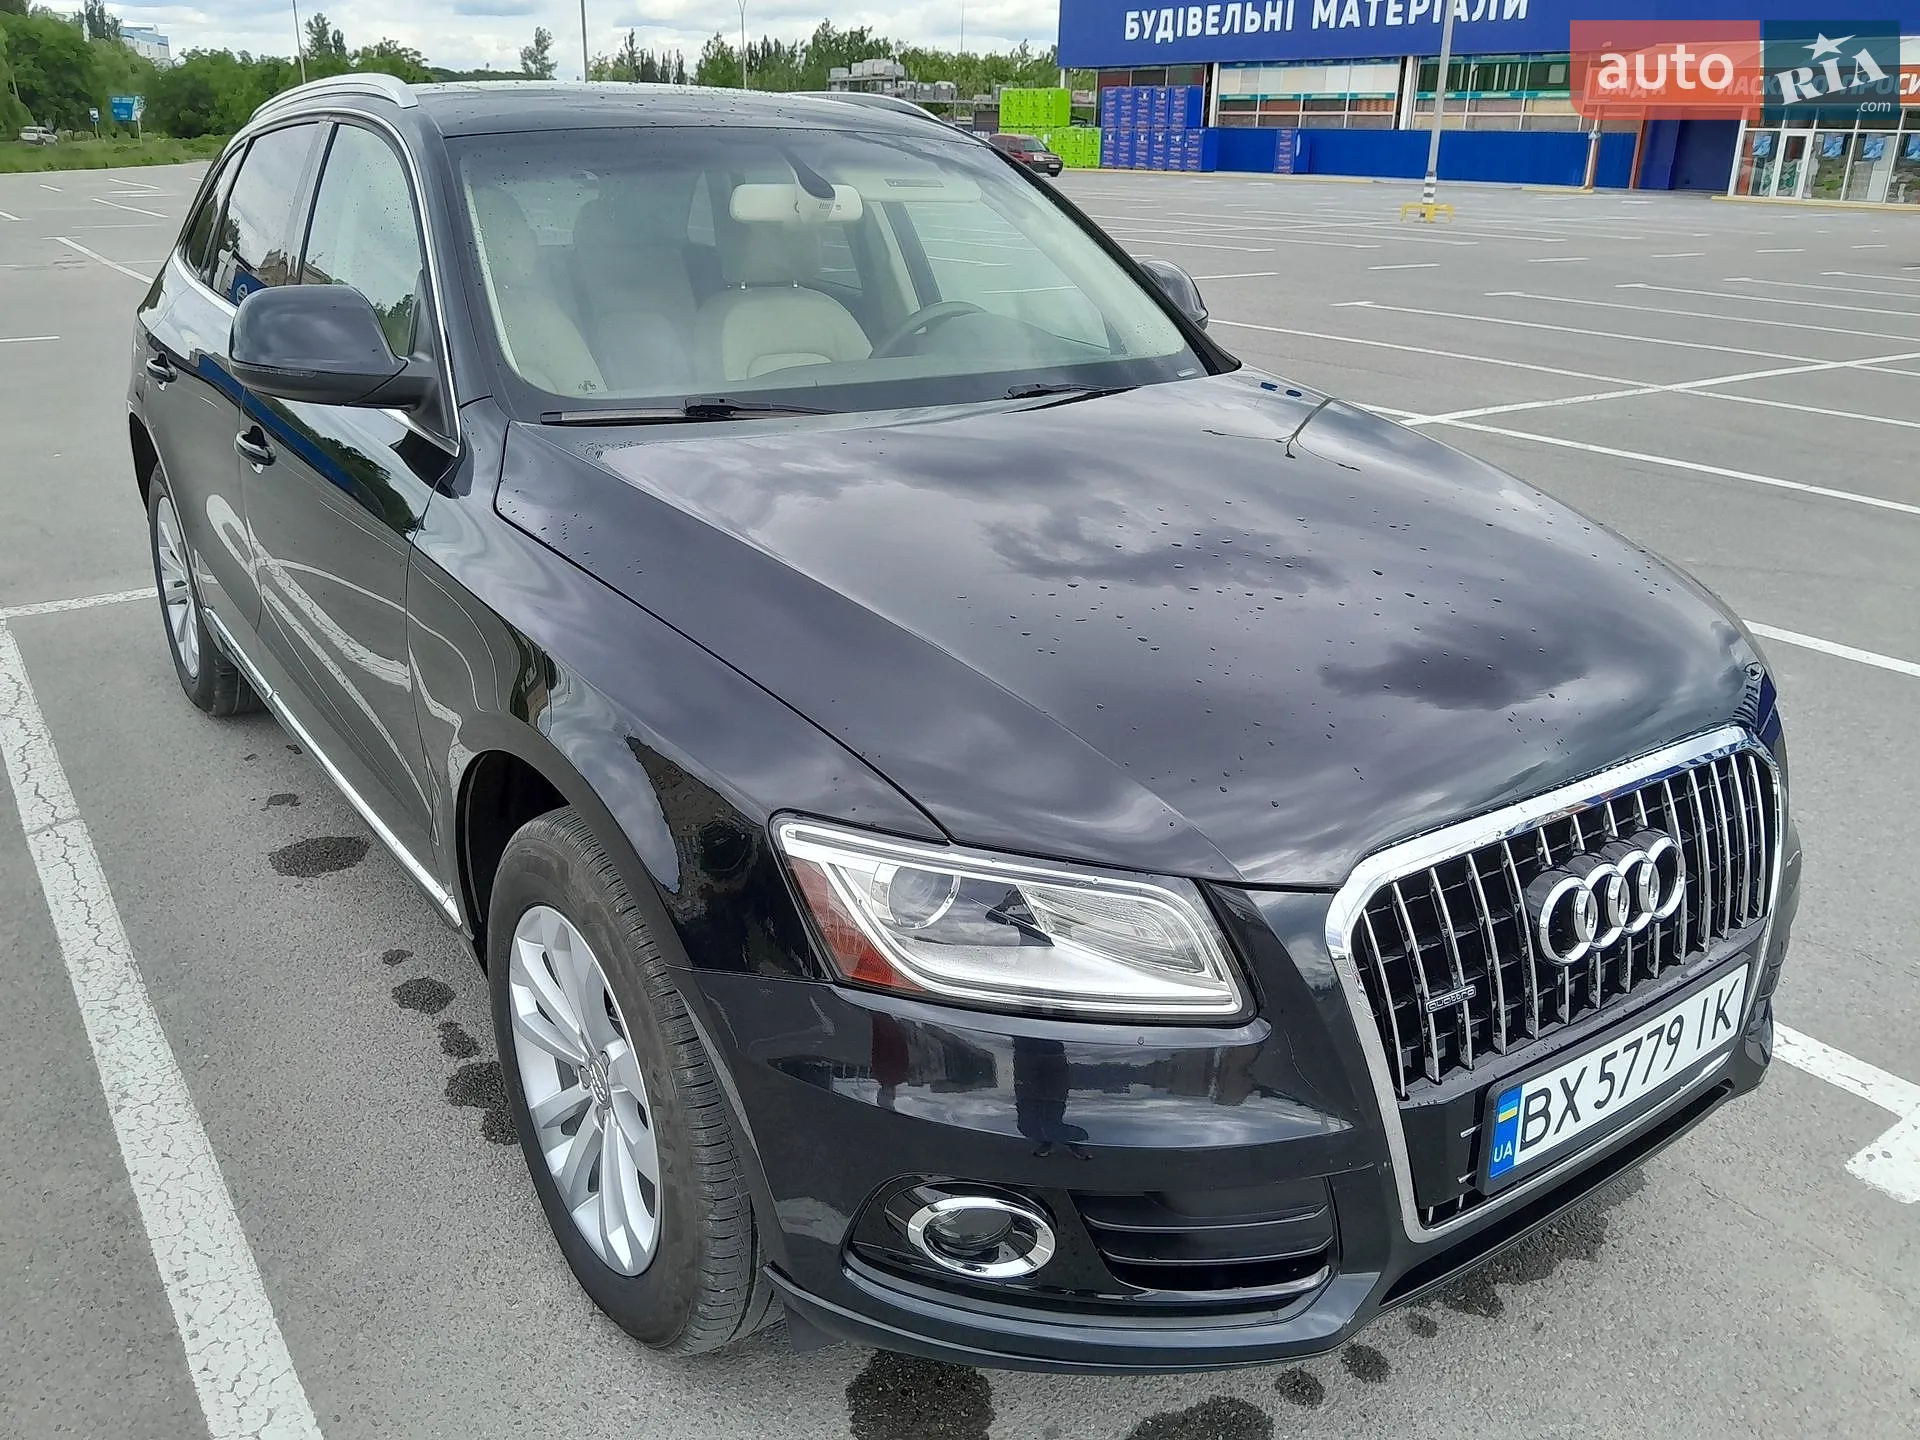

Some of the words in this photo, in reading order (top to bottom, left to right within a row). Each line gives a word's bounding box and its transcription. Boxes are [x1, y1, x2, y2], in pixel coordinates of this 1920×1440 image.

[1124, 0, 1295, 44] БУДІВЕЛЬНІ
[1311, 0, 1529, 30] МАТЕРІАЛИ
[1428, 988, 1475, 1010] quattro
[1519, 1065, 1588, 1153] BX
[1593, 1015, 1685, 1110] 5779
[1696, 977, 1741, 1051] IK
[1493, 1140, 1513, 1163] UA
